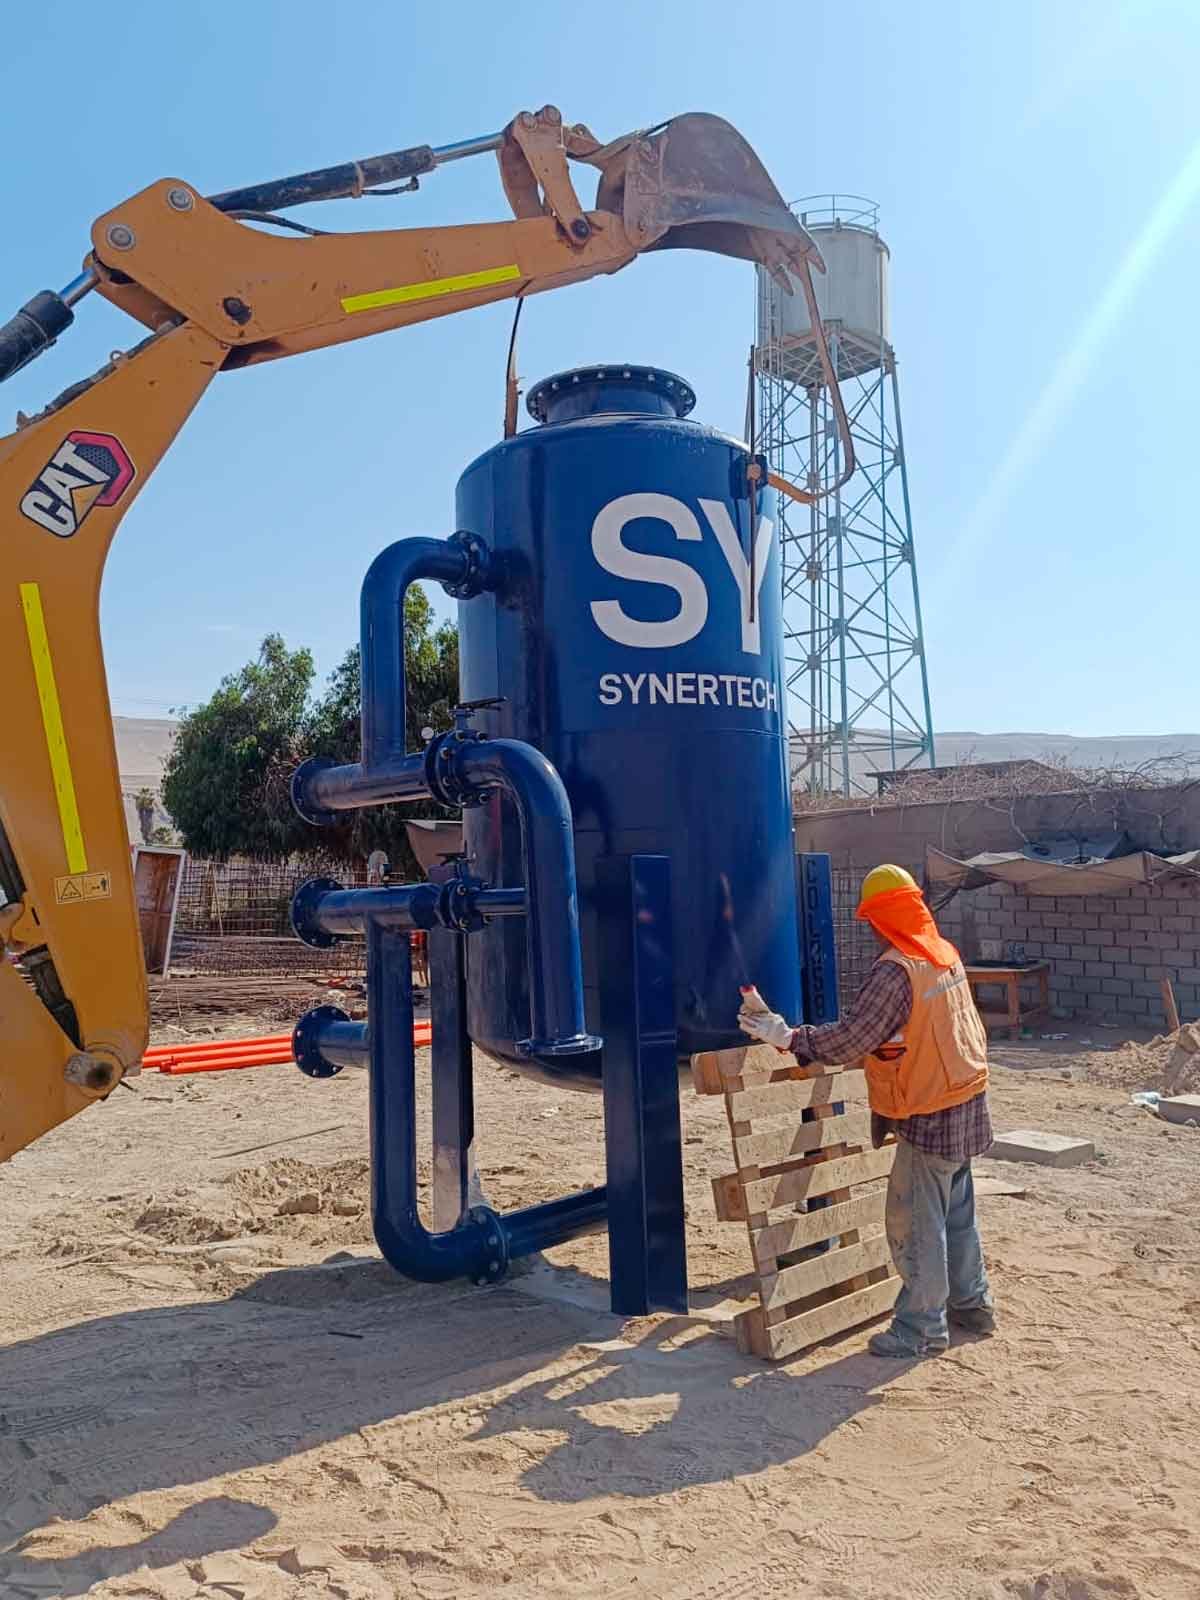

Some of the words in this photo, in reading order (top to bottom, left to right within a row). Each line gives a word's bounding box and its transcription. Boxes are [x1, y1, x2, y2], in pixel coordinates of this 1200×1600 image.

[20, 440, 111, 537] CAT
[590, 492, 774, 655] SY
[599, 672, 778, 712] SYNERTECH
